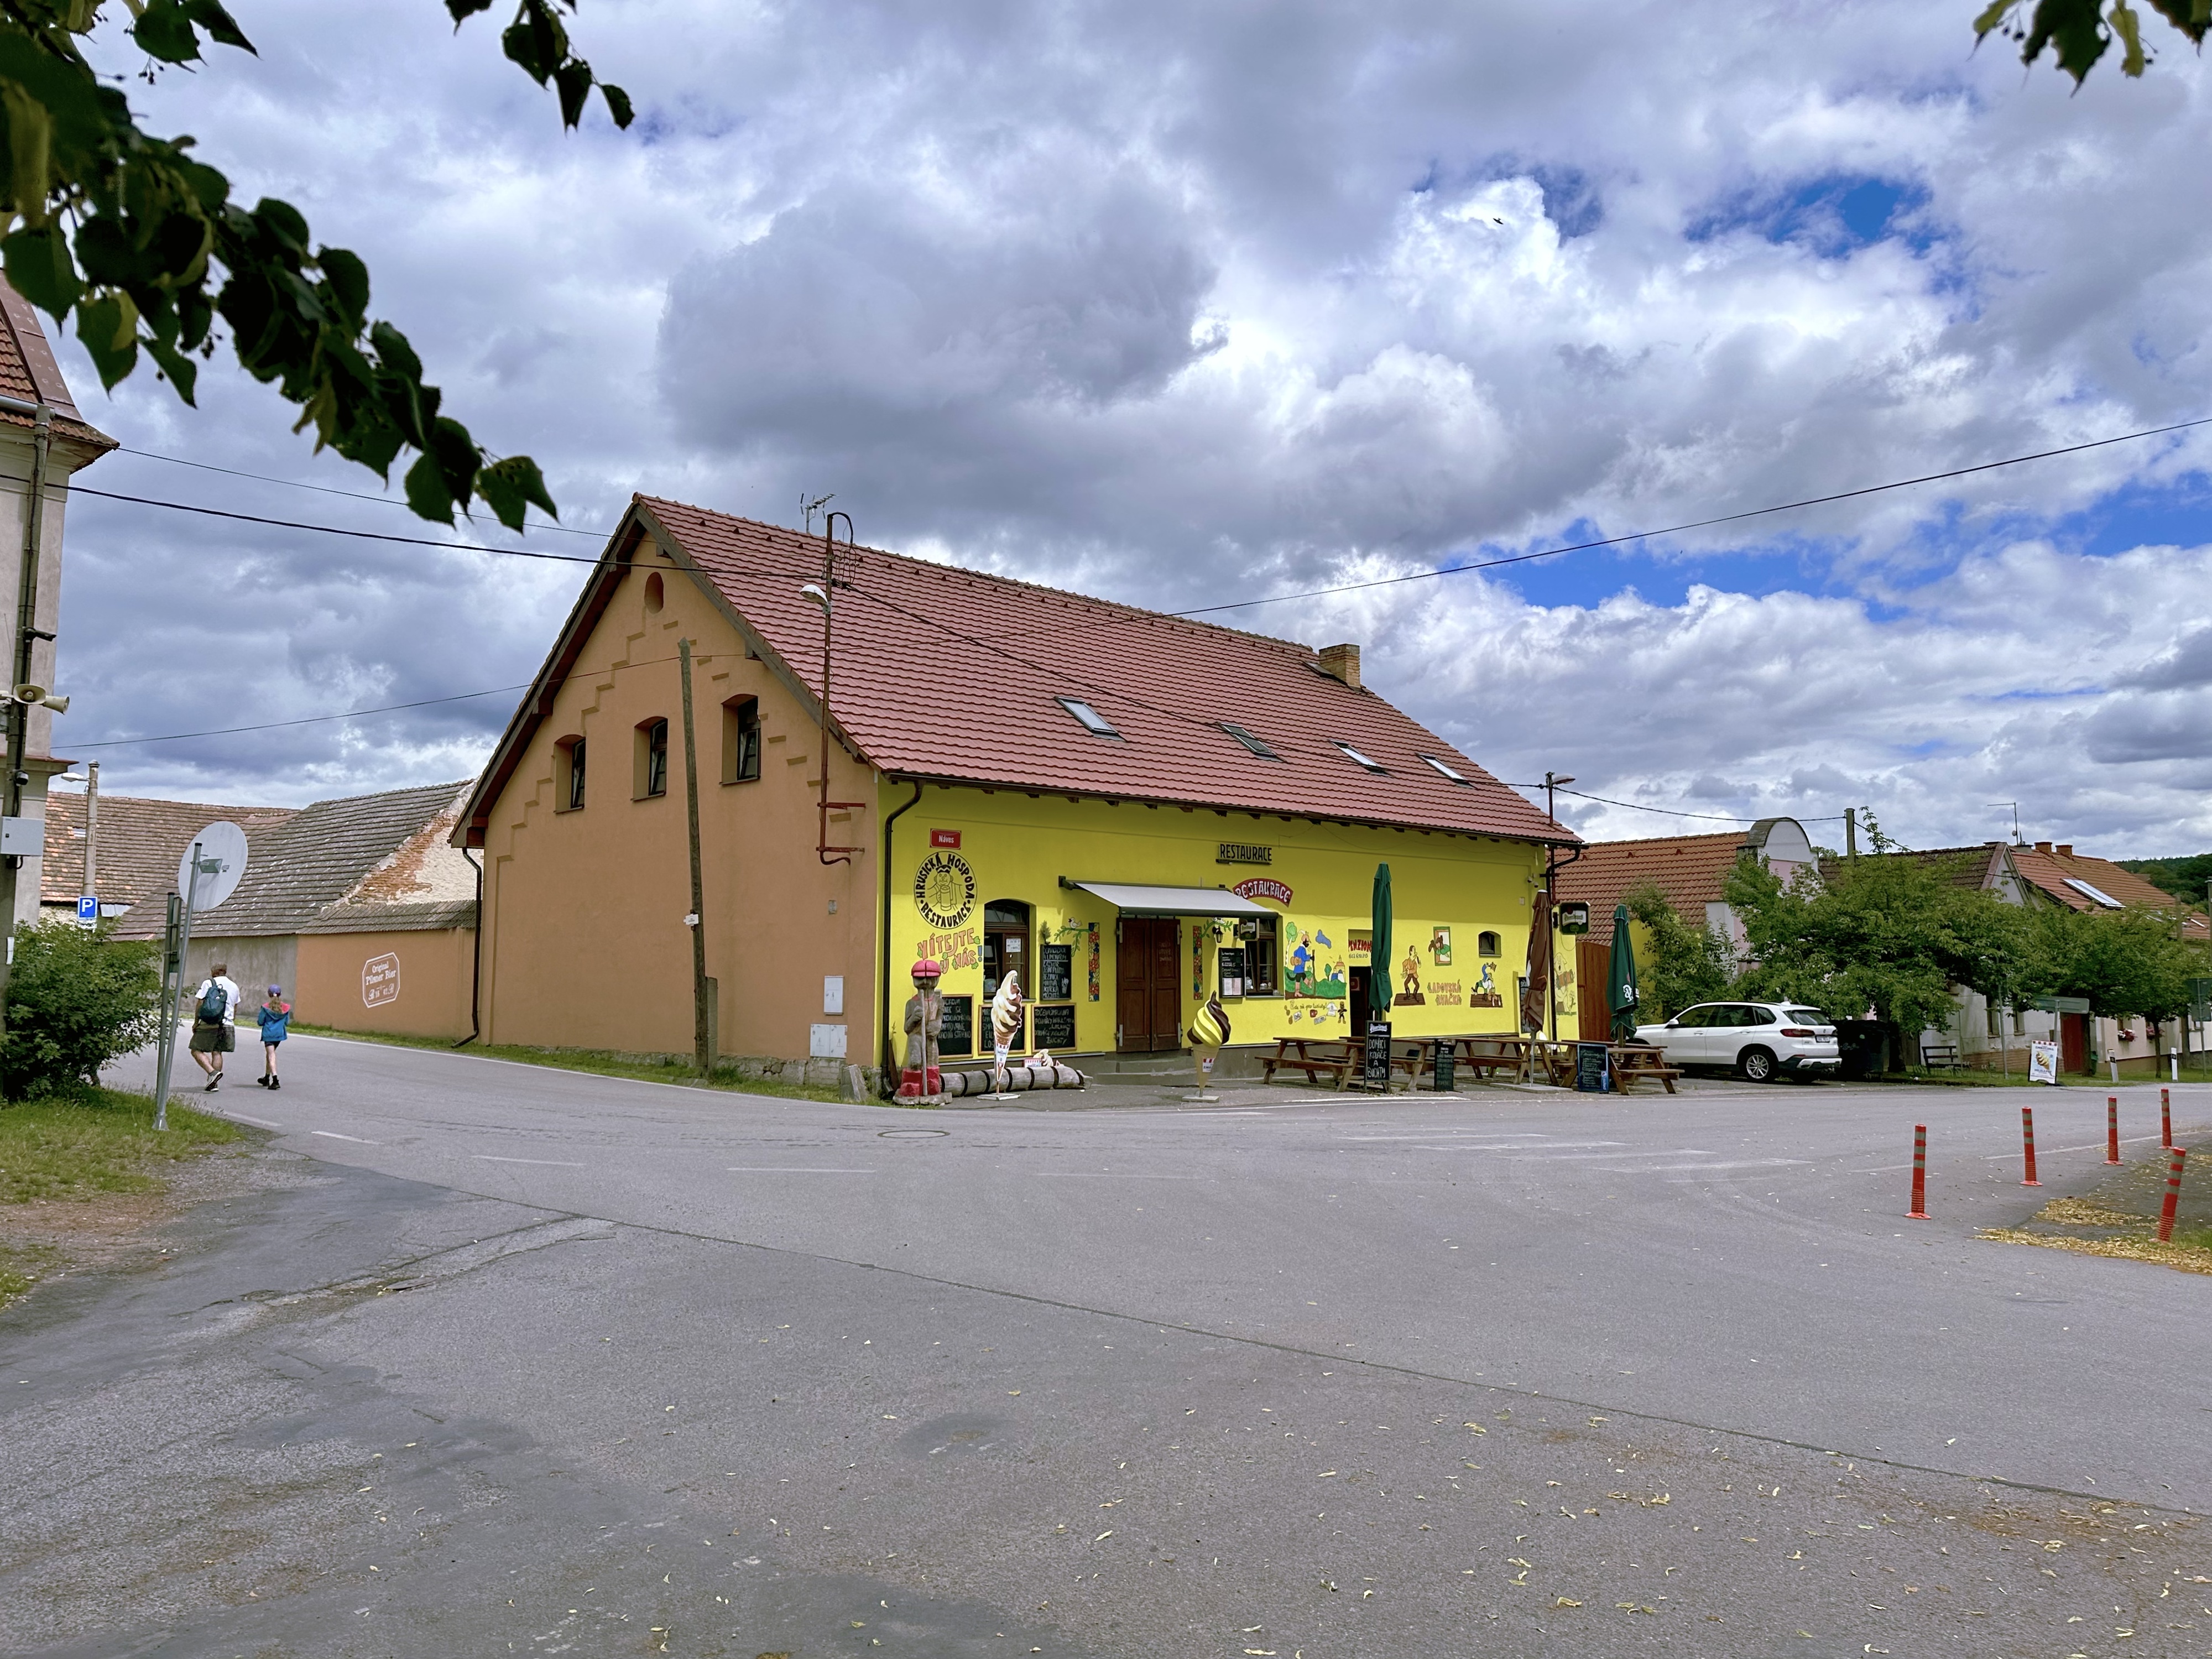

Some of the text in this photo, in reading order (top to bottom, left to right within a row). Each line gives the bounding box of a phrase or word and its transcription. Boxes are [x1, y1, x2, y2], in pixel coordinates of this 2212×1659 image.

[938, 835, 954, 843] Náves
[1220, 843, 1272, 861] RESTAURACE
[916, 852, 974, 899] HRUSICKÁ HOSPODA
[1235, 880, 1291, 902] RESTAURACE
[82, 899, 93, 912] P
[920, 902, 971, 927] RESTAURACE
[917, 927, 974, 960] VÍTEJTE
[1348, 939, 1373, 952] PENZION
[372, 961, 389, 973] Original
[366, 969, 397, 985] Pilsner Bier
[1428, 979, 1461, 993] LADOVSKÁ
[1436, 993, 1461, 1005] RVAČKA
[1367, 1066, 1386, 1078] BUCHTY
